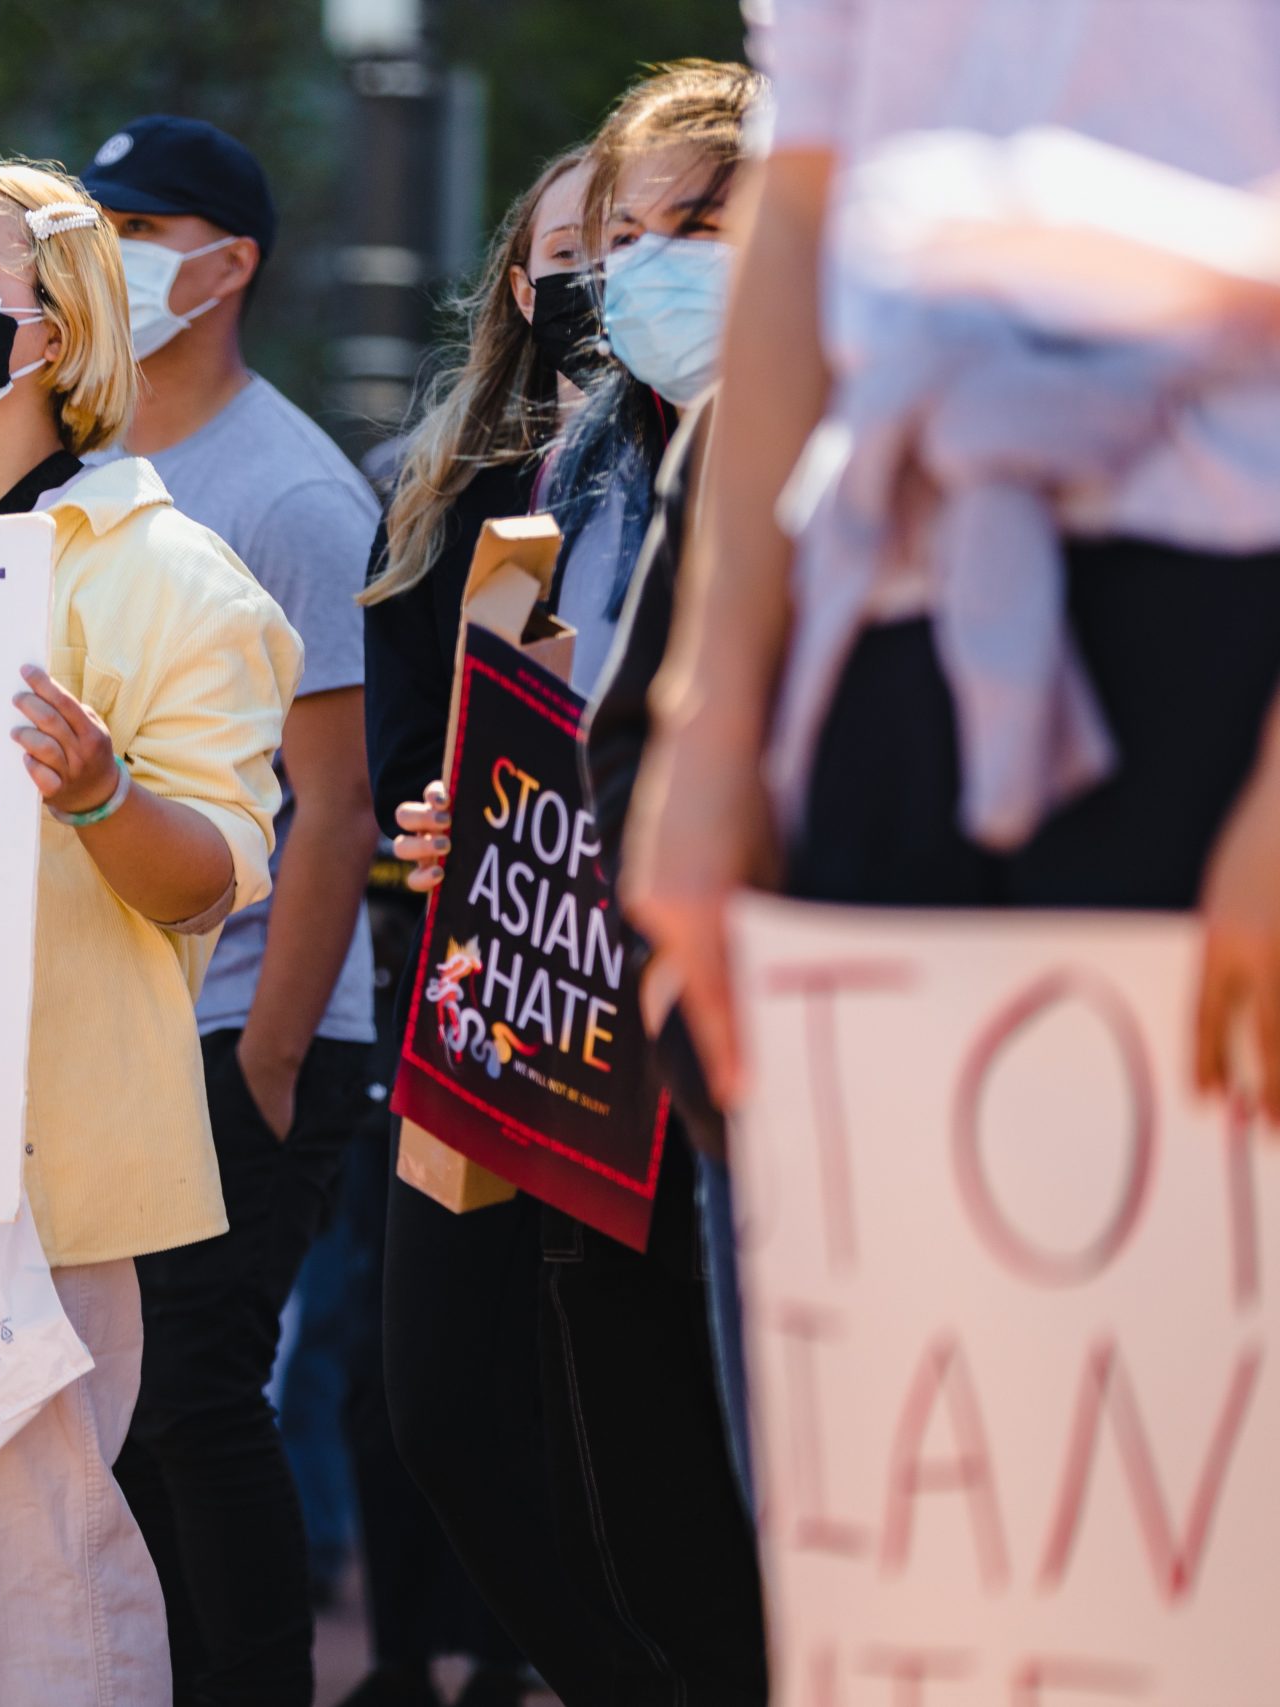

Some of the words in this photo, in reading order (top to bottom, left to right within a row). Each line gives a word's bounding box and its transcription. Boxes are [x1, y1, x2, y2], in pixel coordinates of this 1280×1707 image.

[483, 756, 602, 878] STOP
[467, 843, 624, 989] ASIAN
[481, 938, 618, 1072] HATE
[514, 1059, 527, 1076] WE
[528, 1067, 547, 1088] WILL
[548, 1077, 567, 1097] NOT
[580, 1093, 610, 1116] SILENT
